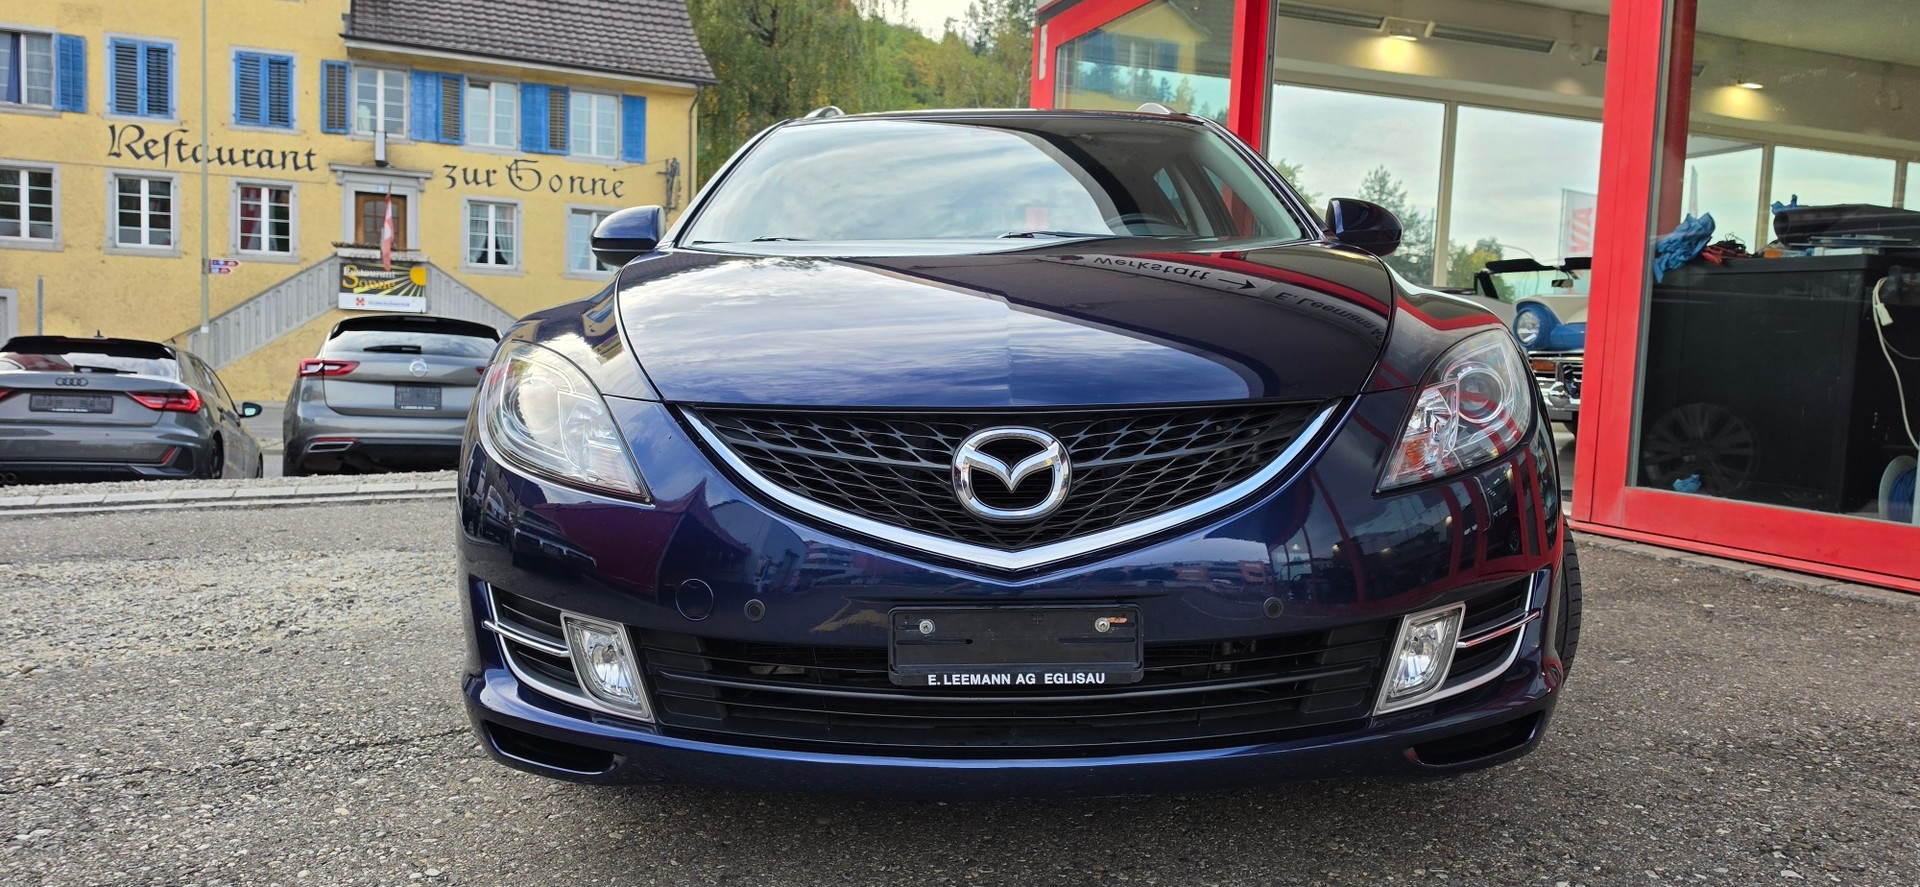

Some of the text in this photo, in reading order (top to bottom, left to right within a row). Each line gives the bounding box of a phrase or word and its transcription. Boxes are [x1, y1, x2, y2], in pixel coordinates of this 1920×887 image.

[107, 124, 318, 172] Restaurant
[442, 159, 625, 198] zur Sonne
[927, 672, 1106, 686] E. LEEMANN AG EGLISAU
